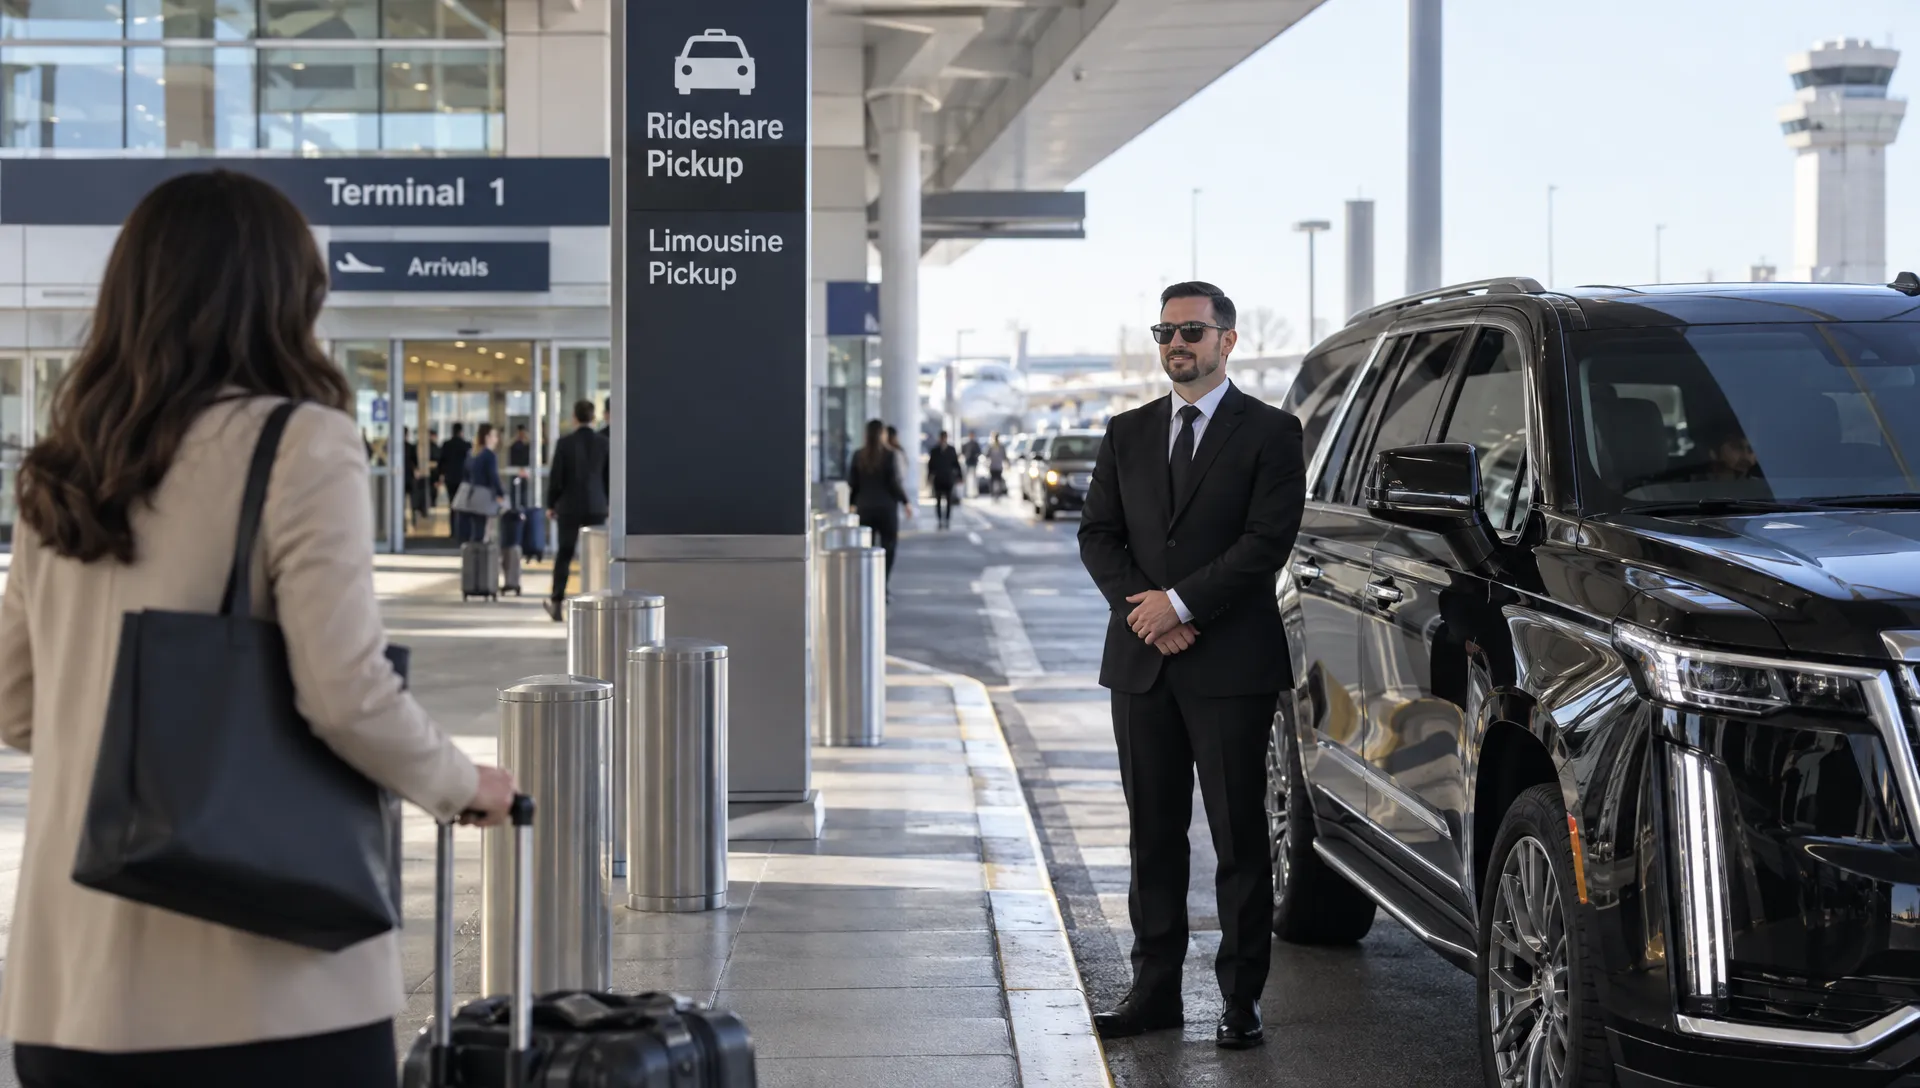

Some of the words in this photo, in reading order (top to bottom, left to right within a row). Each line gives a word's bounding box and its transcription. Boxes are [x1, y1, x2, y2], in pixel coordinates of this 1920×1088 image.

[647, 111, 784, 140] Rideshare
[647, 149, 744, 184] Pickup
[326, 177, 465, 207] Terminal
[489, 177, 504, 206] 1
[649, 228, 784, 253] Limousine
[407, 256, 489, 277] Arrivals
[649, 260, 737, 291] Pickup
